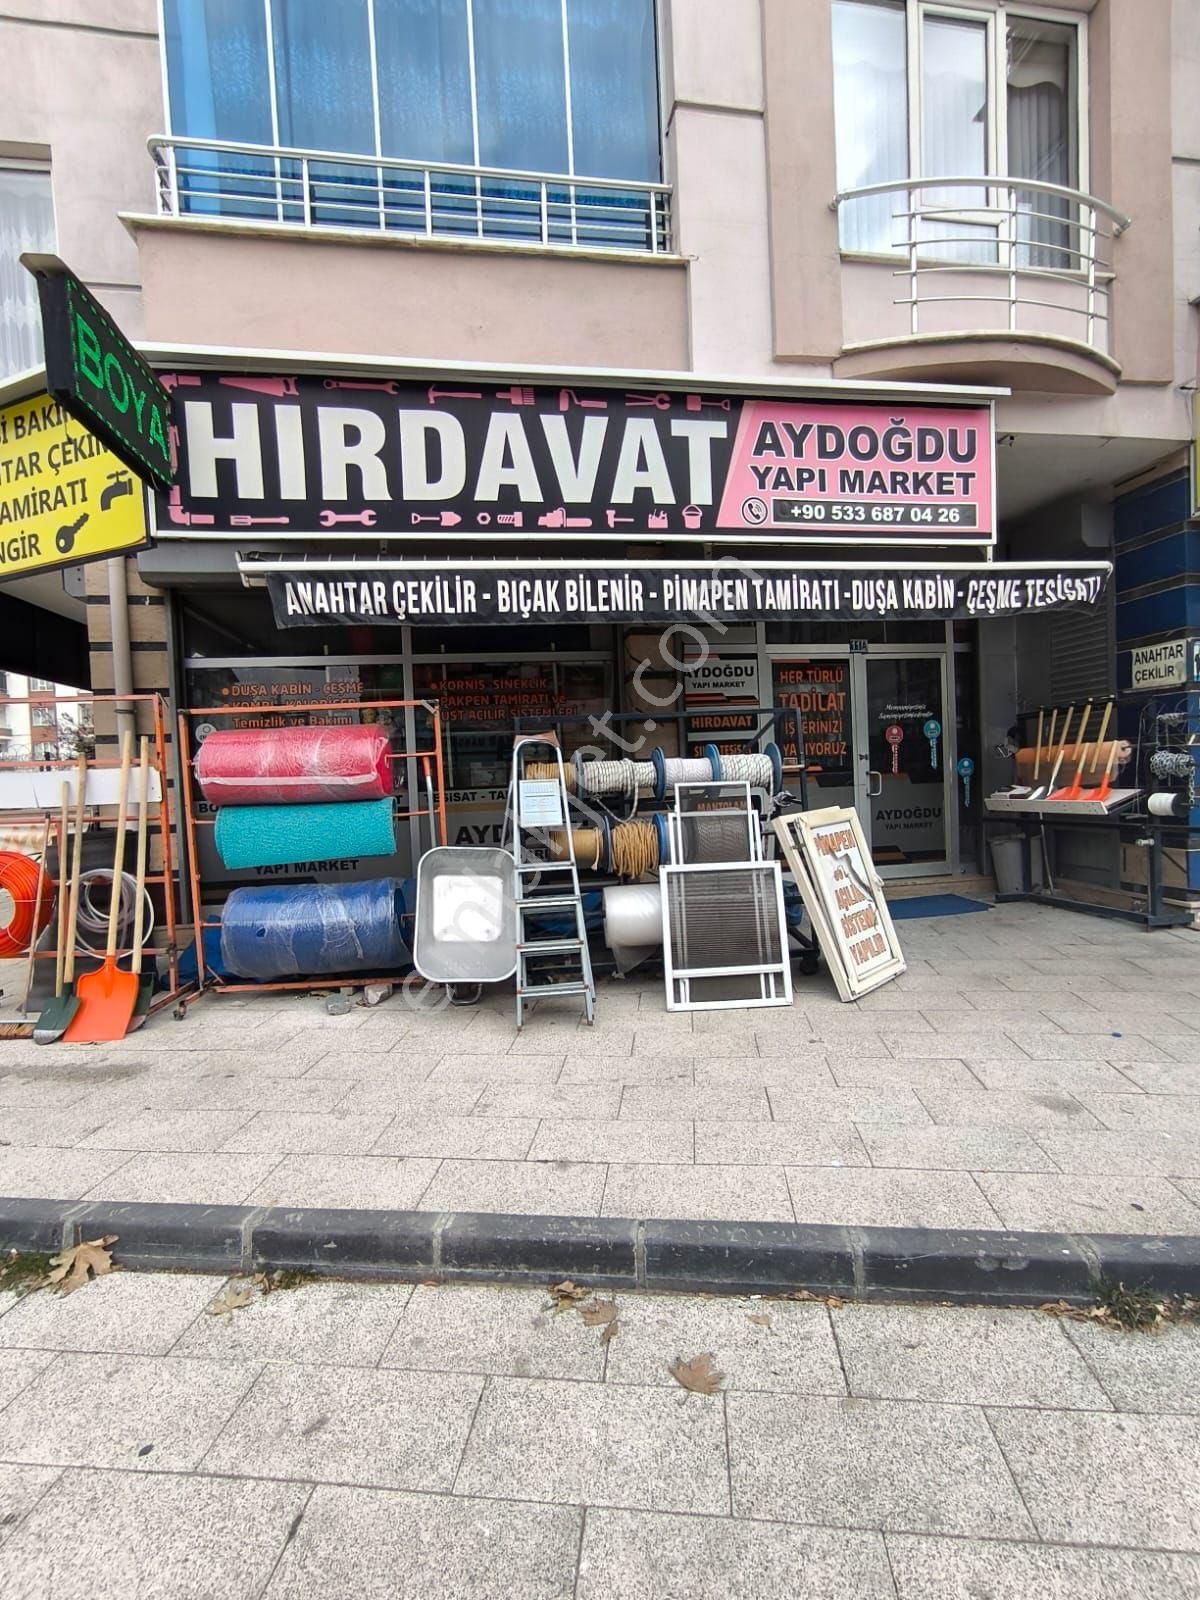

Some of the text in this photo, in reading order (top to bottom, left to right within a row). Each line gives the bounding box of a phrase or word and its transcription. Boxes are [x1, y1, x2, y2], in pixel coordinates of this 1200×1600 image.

[76, 313, 169, 461] BOYA
[752, 417, 977, 464] AYDOĞDU
[184, 401, 727, 505] HIRDAVAT
[750, 465, 977, 495] YAPI MARKET
[791, 504, 960, 523] +90 533 687 04 26
[285, 582, 388, 615] ANAHTAR
[393, 575, 477, 619] ÇEKİLİR
[497, 579, 560, 618] BIÇAK
[565, 574, 644, 612] BİLENİR
[663, 574, 748, 611] PİMAPEN
[752, 574, 840, 610] TAMİRATI
[903, 574, 954, 609] KABİN
[967, 579, 1021, 614] ÇEŞME
[1134, 644, 1184, 666] ANAHTAR
[780, 667, 843, 684] HER TÜRLÜ
[1135, 664, 1175, 684] ÇEKİLİR
[779, 686, 847, 712] TADİLAT
[233, 716, 286, 729] Temizlik
[290, 717, 305, 727] ve
[691, 715, 753, 729] HIRDAVAT
[783, 742, 847, 756] YAIYORUZ
[876, 805, 942, 820] AYDOĞDU
[255, 859, 360, 875] YAPI MARKET
